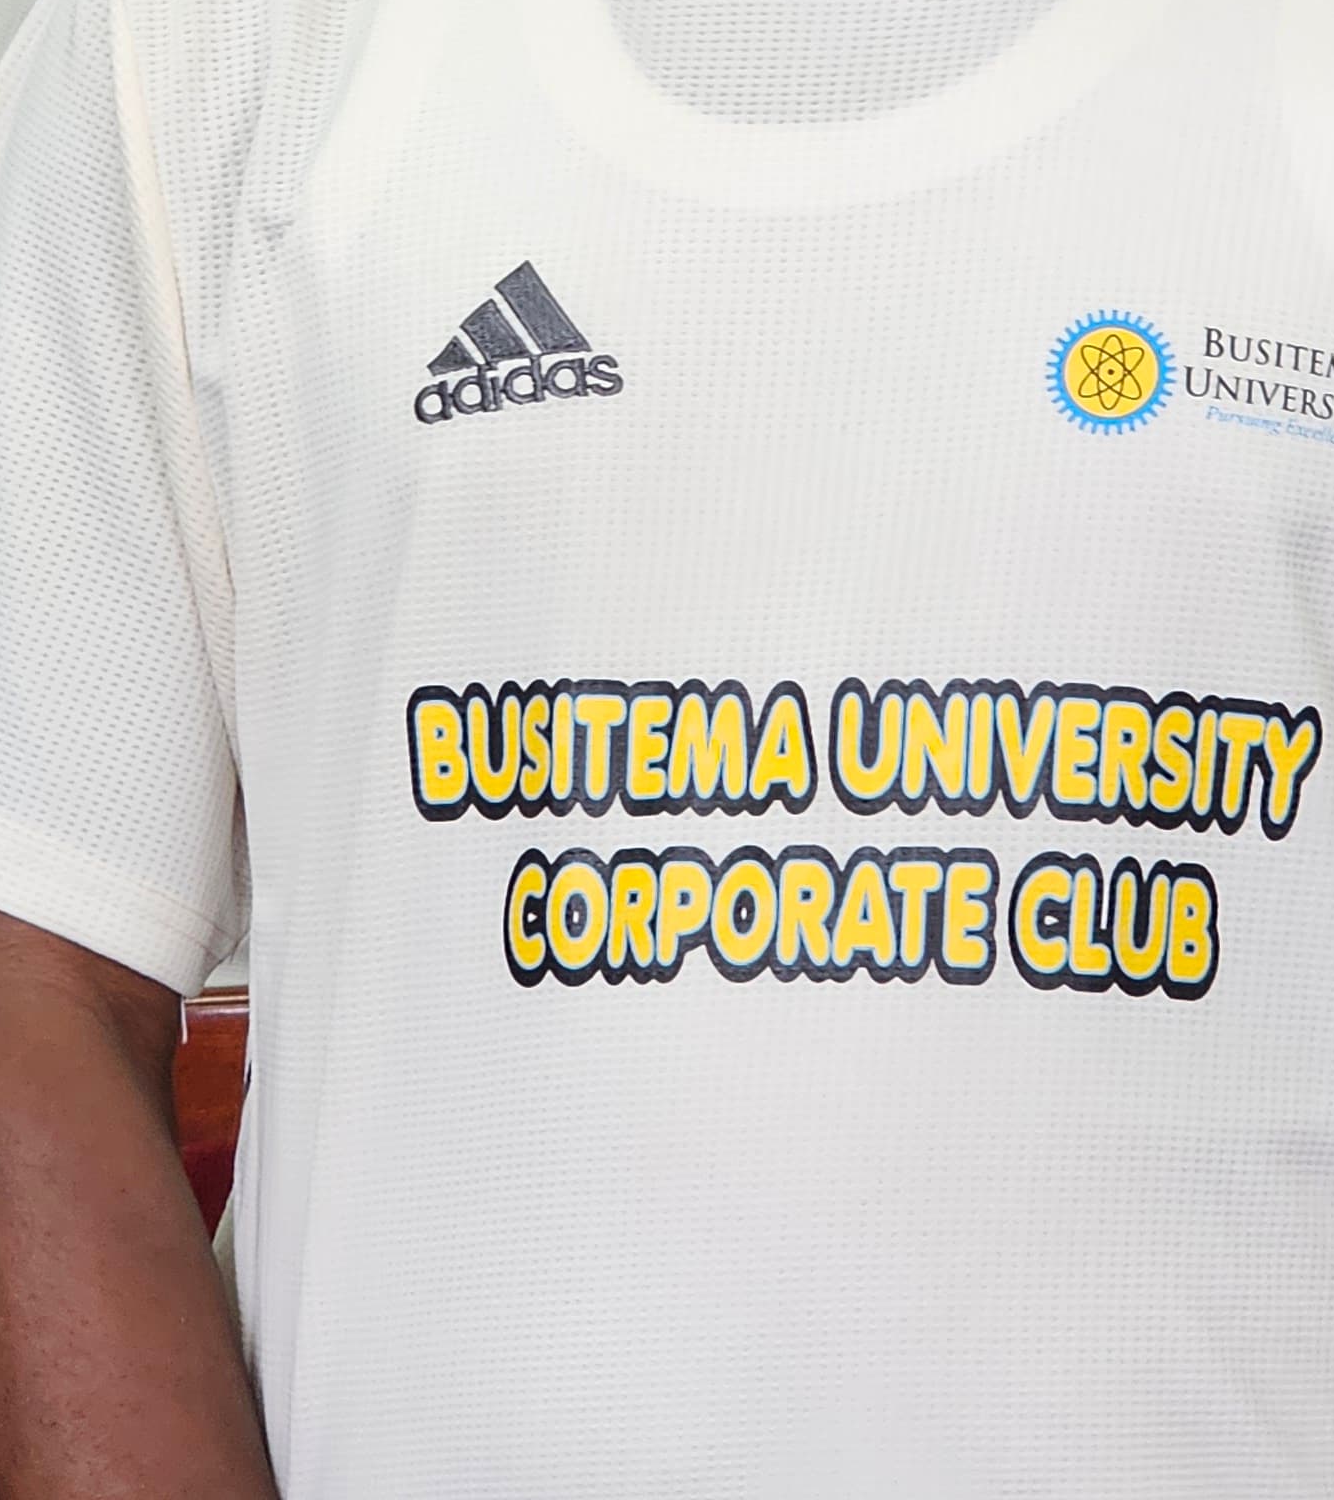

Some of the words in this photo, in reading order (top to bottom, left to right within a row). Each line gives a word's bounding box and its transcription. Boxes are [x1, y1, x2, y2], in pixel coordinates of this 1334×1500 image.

[413, 354, 624, 425] adidas
[407, 678, 815, 821] BUSITEMA
[829, 678, 1323, 840] UNIVERSITY
[503, 844, 998, 986] CORPORATE
[1007, 853, 1220, 1000] CLUB
